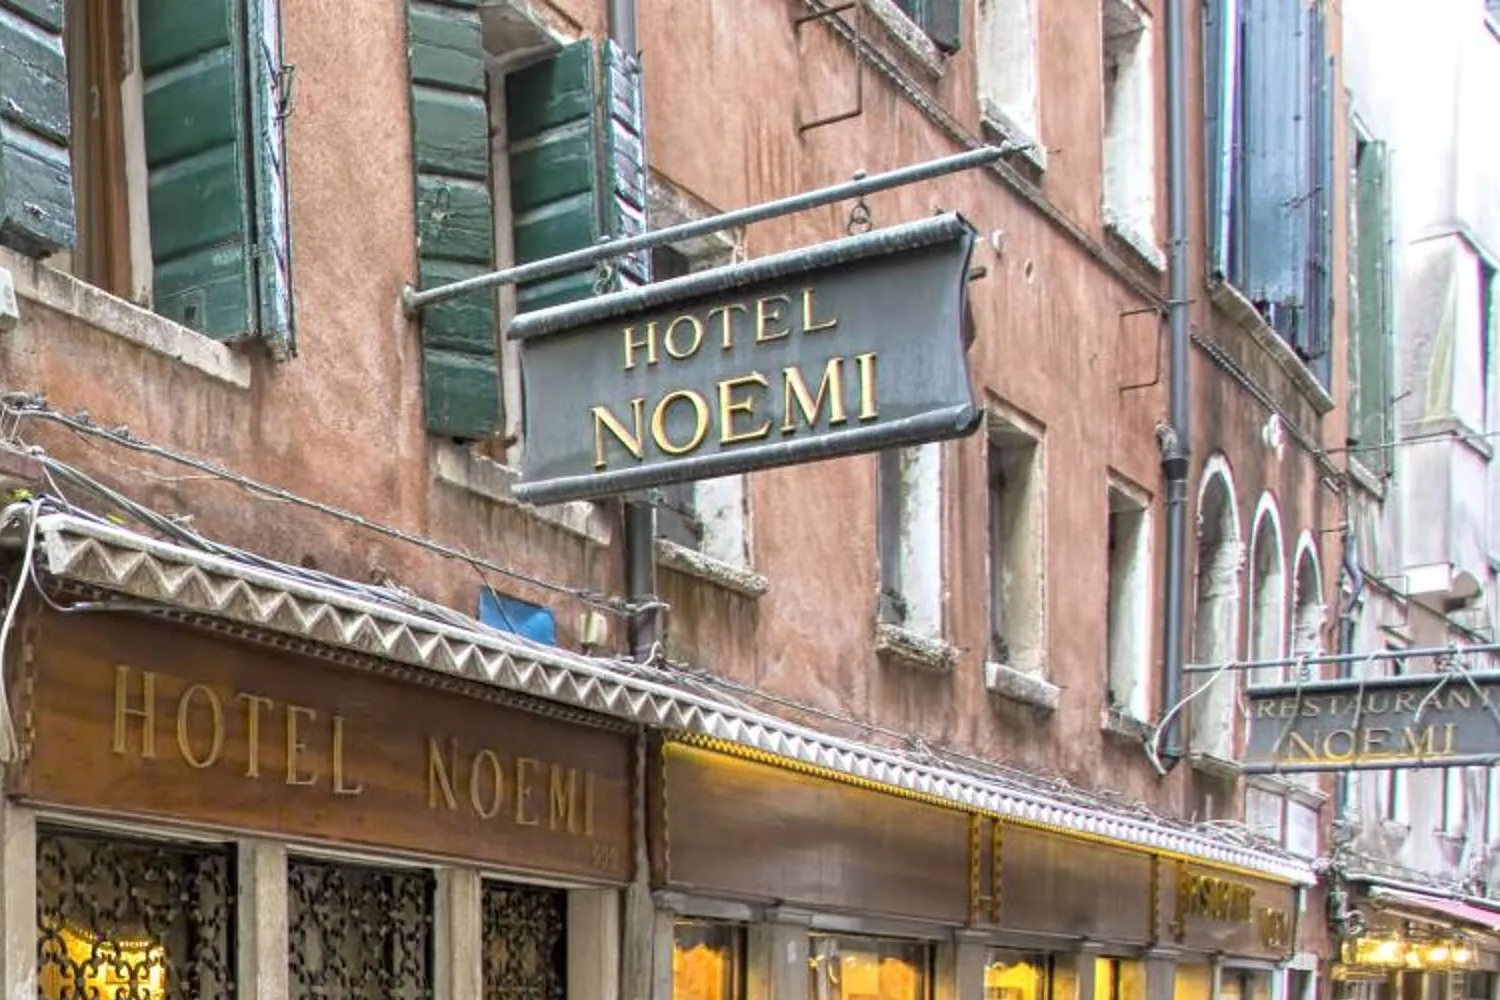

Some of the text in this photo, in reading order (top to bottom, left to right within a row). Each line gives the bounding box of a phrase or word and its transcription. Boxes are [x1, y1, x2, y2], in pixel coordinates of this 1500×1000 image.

[623, 287, 838, 371] HOTEL
[591, 351, 879, 469] NOEMI
[112, 664, 598, 837] HOTEL NOEMI
[1285, 723, 1457, 763] NOEMI
